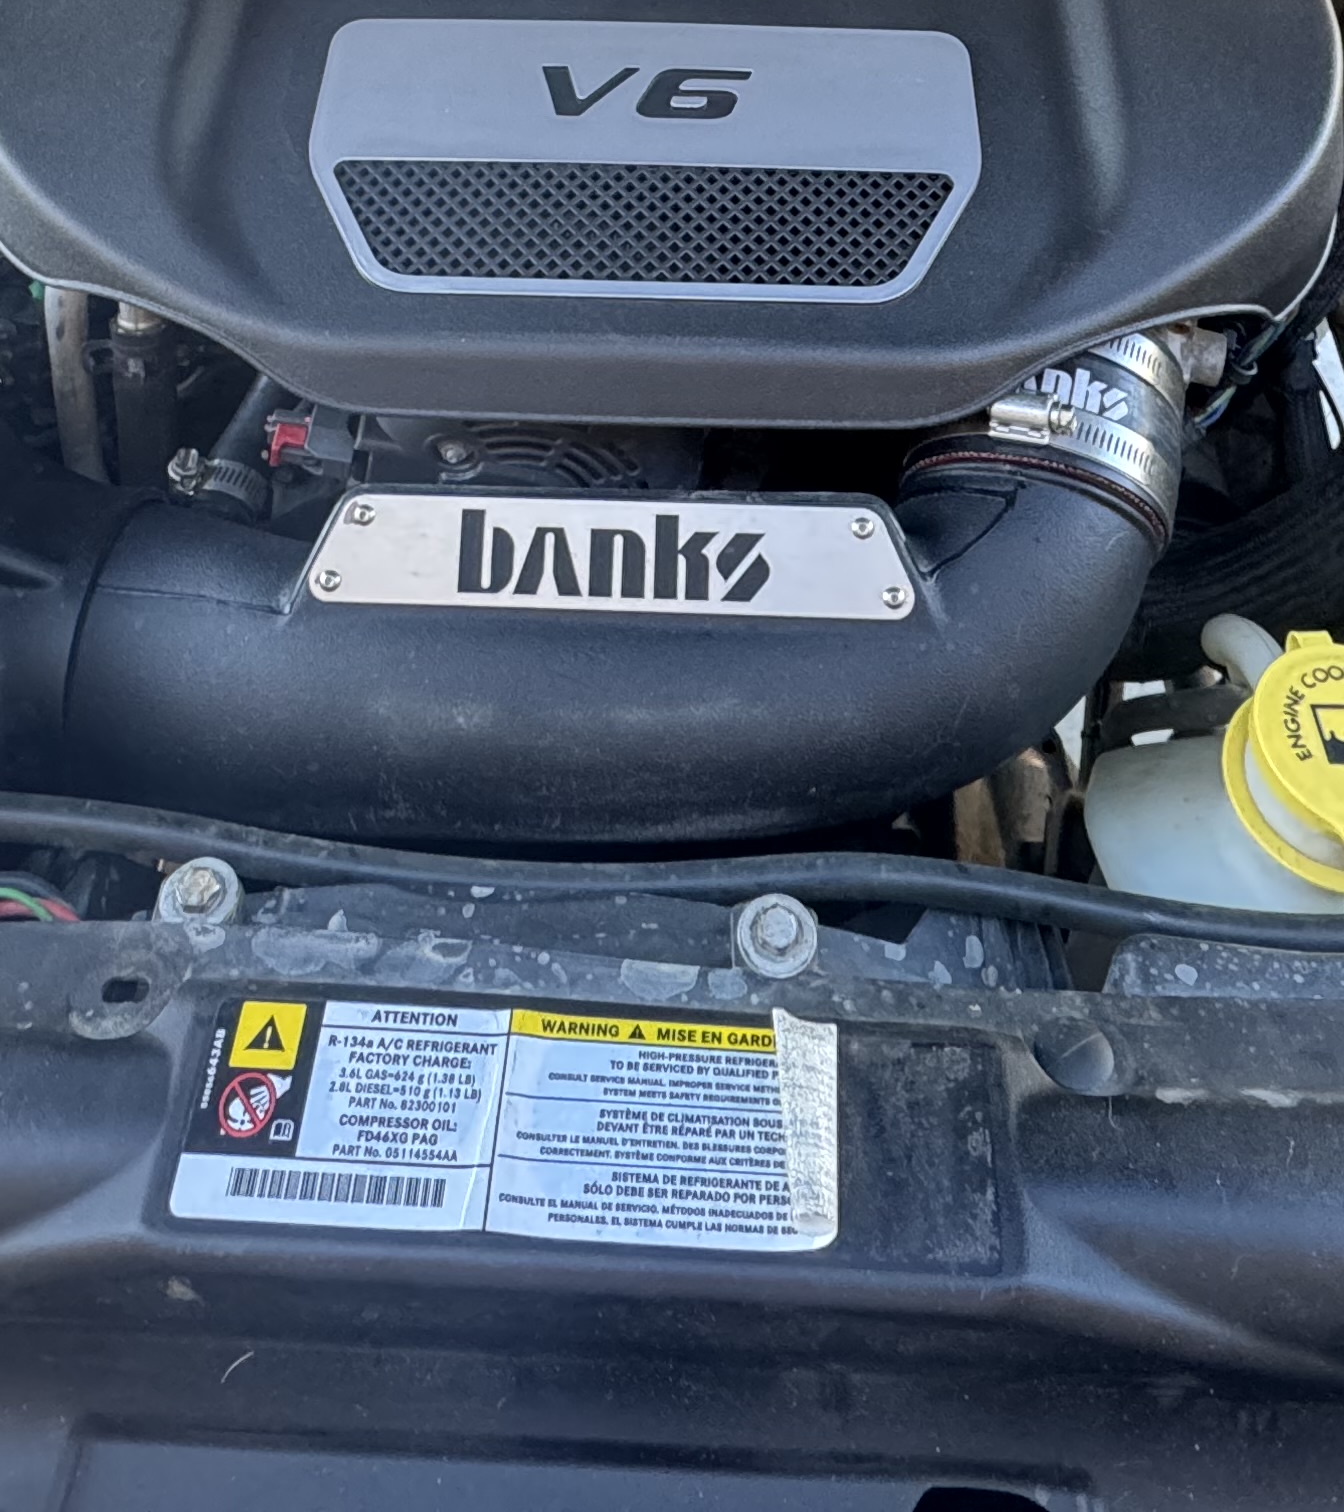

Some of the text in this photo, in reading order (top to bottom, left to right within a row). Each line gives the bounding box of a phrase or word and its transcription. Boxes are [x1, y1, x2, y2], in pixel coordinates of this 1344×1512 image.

[542, 65, 754, 119] V6
[457, 508, 772, 602] banks
[1284, 686, 1313, 761] ENGINE
[371, 1009, 458, 1027] ATTENTION
[541, 1018, 776, 1048] WARNING MISE EN GARD
[328, 1035, 498, 1055] R-134a A/C REFRIGERANT
[349, 1051, 472, 1069] FACTORY CHARGE:
[638, 1050, 722, 1064] HIGH-PRESSURE
[339, 1067, 475, 1087] 3.6L GAS=624 g (1.38 LB)
[610, 1060, 624, 1070] TO
[627, 1061, 640, 1071] BE
[642, 1062, 694, 1075] SERVICED
[696, 1065, 710, 1076] BY
[713, 1067, 769, 1080] QUALIFIED
[328, 1080, 482, 1103] 2.8L DIESEL=510 g (1.13 LB)
[548, 1072, 588, 1083] CONSULT
[590, 1074, 625, 1084] SERVICE
[668, 1079, 713, 1090] IMPROPER
[715, 1082, 750, 1092] SERVICE
[348, 1096, 456, 1113] PART No. 82300101
[603, 1088, 637, 1097] SYSTEM
[639, 1090, 667, 1100] MEETS
[669, 1092, 701, 1102] SAFETY
[703, 1094, 770, 1106] REQUIREMENTS
[339, 1114, 457, 1132] COMPRESSOR OIL:
[599, 1108, 783, 1129] SYSTÈME DE CLIMATISATION SOUS
[412, 1133, 439, 1146] PAG
[597, 1121, 639, 1134] DEVANT
[642, 1122, 669, 1135] ÊTRE
[671, 1124, 712, 1138] RÉPARÉ
[715, 1128, 736, 1139] PAR
[739, 1130, 755, 1140] UN
[516, 1131, 568, 1143] CONSULTER
[570, 1135, 580, 1143] LE
[582, 1136, 619, 1146] MANUEL
[682, 1141, 700, 1150] DES
[702, 1142, 752, 1154] BLESSURES
[332, 1144, 457, 1162] PART No. 05114554AA
[614, 1149, 654, 1162] SYSTÈME
[657, 1153, 706, 1165] CONFORME
[708, 1156, 727, 1166] AUX
[729, 1156, 771, 1168] CRITÈRES
[611, 1171, 659, 1185] SISTEMA
[662, 1174, 677, 1185] DE
[680, 1175, 762, 1191] REFRIGERANTE
[764, 1181, 780, 1192] DE
[583, 1181, 613, 1196] SÓLO
[616, 1186, 645, 1197] DEBE
[647, 1188, 668, 1199] SER
[671, 1189, 730, 1202] REPARADO
[733, 1193, 756, 1205] POR
[499, 1193, 545, 1207] CONSULTE
[547, 1198, 557, 1208] EL
[560, 1200, 598, 1211] MANUAL
[601, 1202, 613, 1212] DE
[662, 1204, 706, 1216] MÉTODOS
[708, 1208, 774, 1221] INADECUADOS
[776, 1212, 788, 1221] DE
[611, 1217, 621, 1226] EL
[624, 1217, 663, 1228] SISTEMA
[665, 1219, 702, 1231] CUMPLE
[706, 1222, 722, 1232] LAS
[725, 1223, 764, 1234] NORMAS
[767, 1226, 778, 1234] DE
